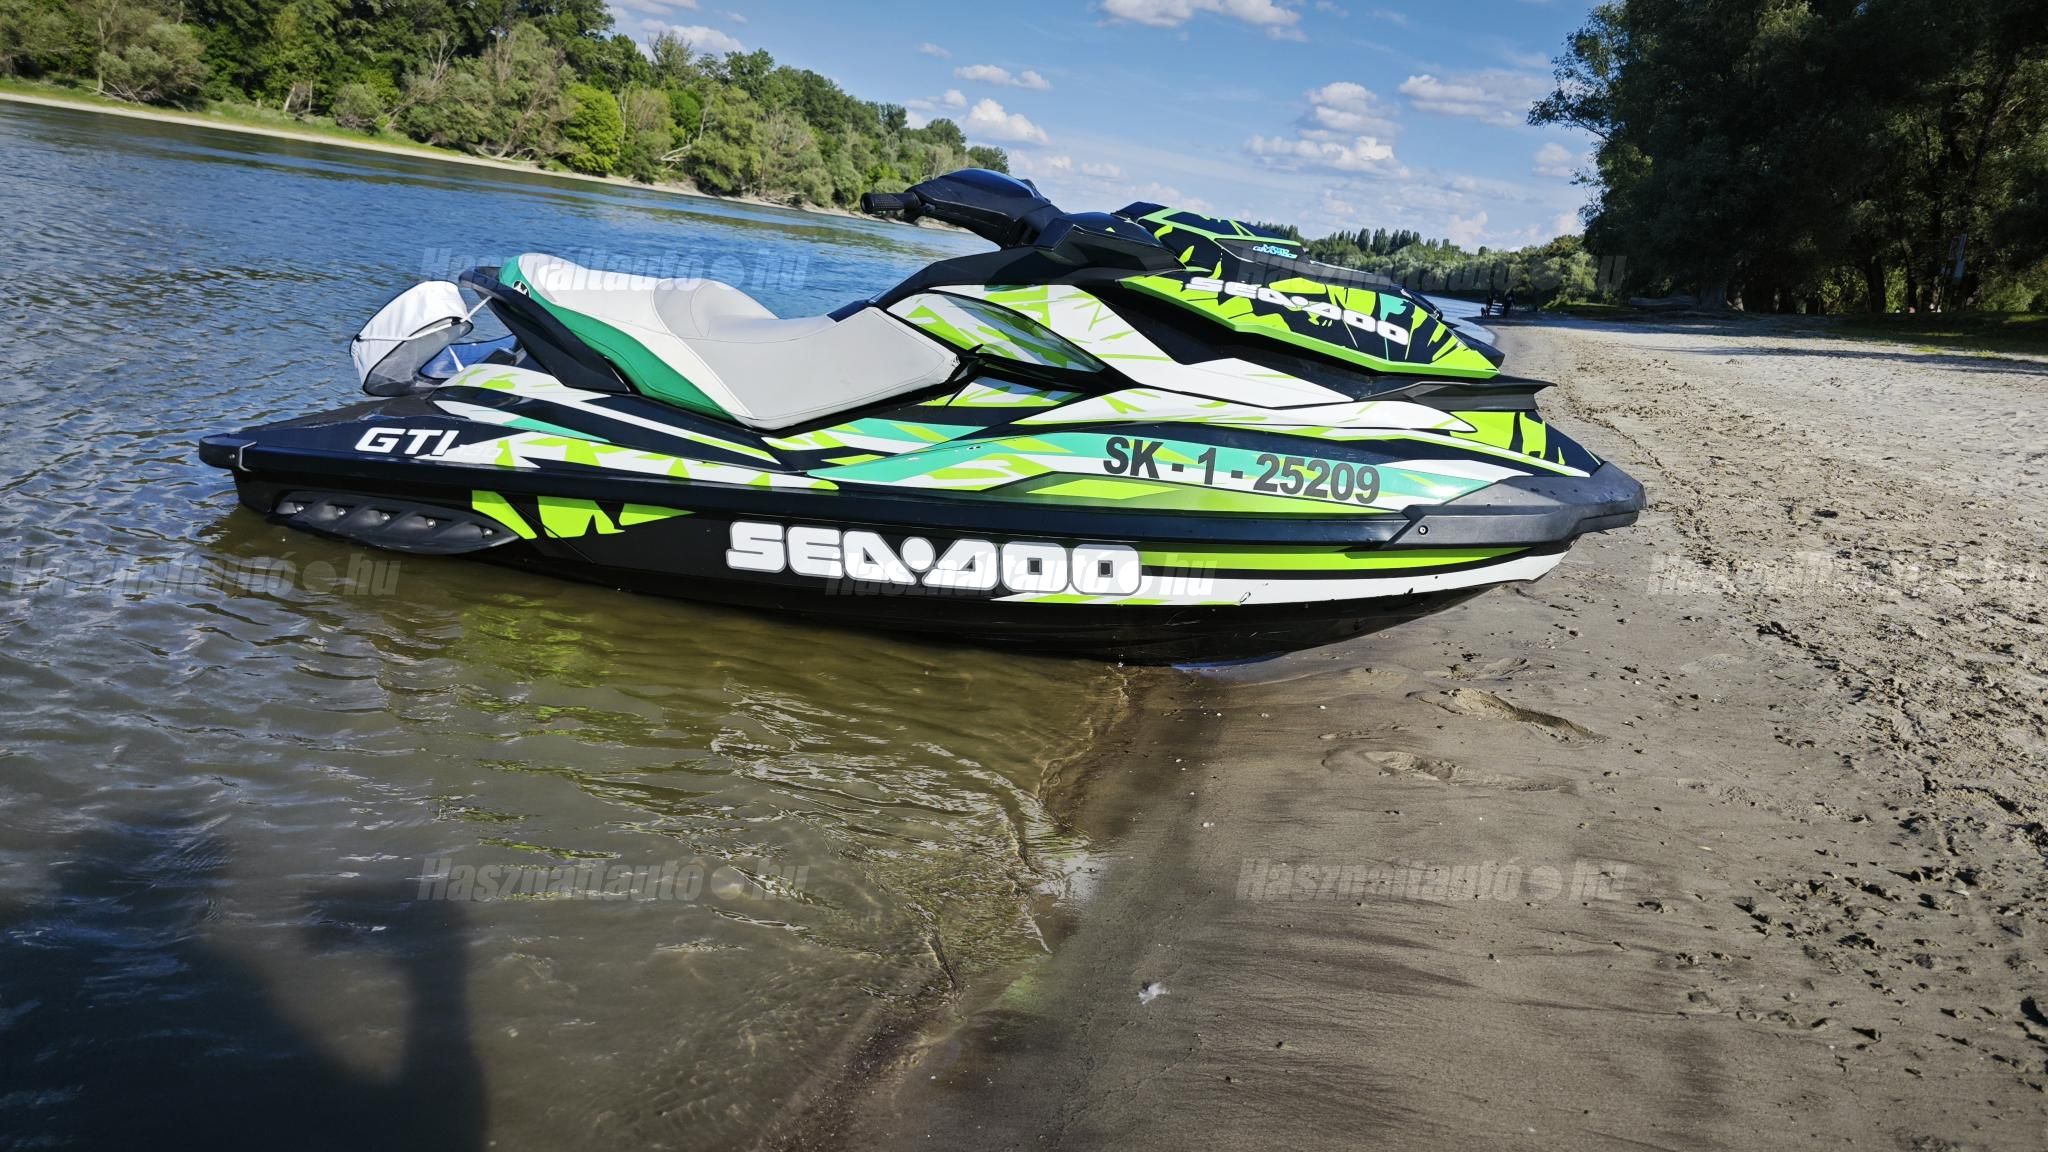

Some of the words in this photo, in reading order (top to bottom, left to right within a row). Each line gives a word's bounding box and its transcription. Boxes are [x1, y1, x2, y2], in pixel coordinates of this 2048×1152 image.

[354, 427, 460, 456] GTI
[1103, 436, 1163, 480] SK
[1197, 447, 1217, 485] 1
[1253, 454, 1380, 504] 25209
